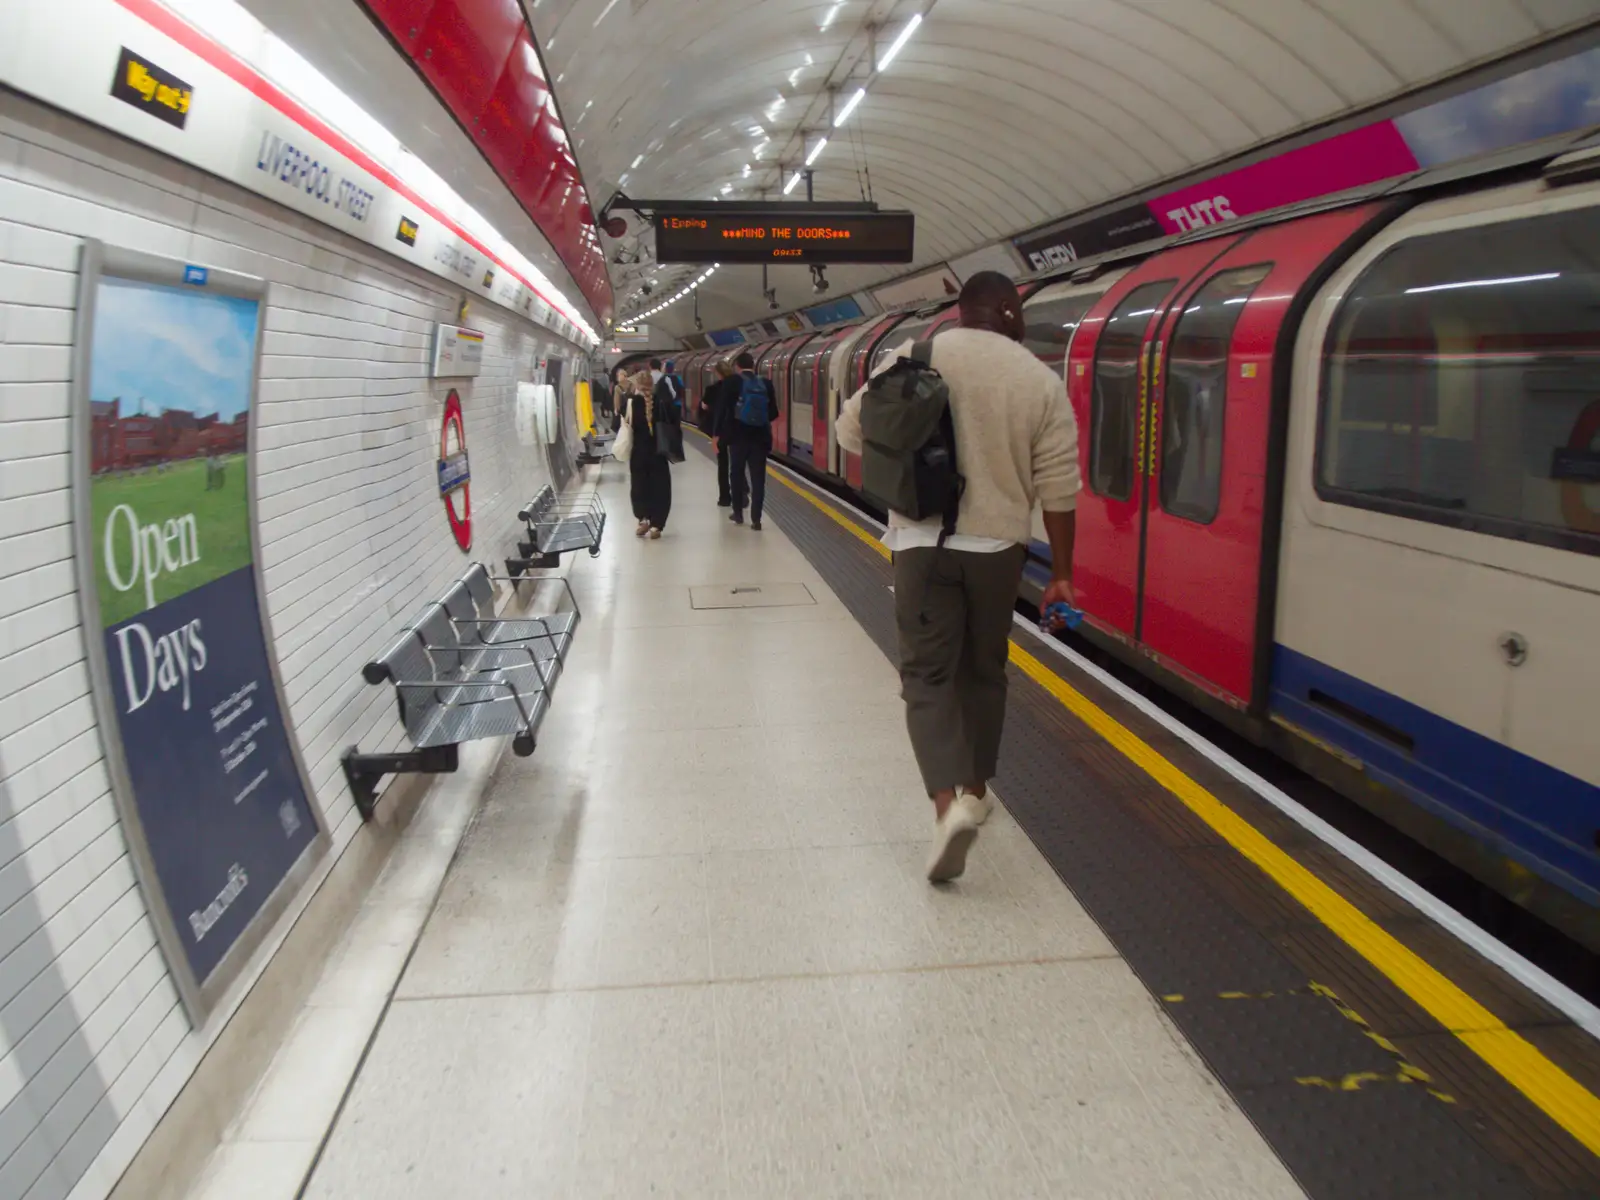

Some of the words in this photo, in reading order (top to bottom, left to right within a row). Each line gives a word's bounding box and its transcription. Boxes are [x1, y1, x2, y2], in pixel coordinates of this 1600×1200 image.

[256, 129, 333, 203] LIVERPOOL
[334, 177, 375, 223] STREET
[671, 217, 707, 229] Epping
[771, 227, 792, 238] THE
[104, 503, 201, 610] Open
[113, 618, 208, 715] Days
